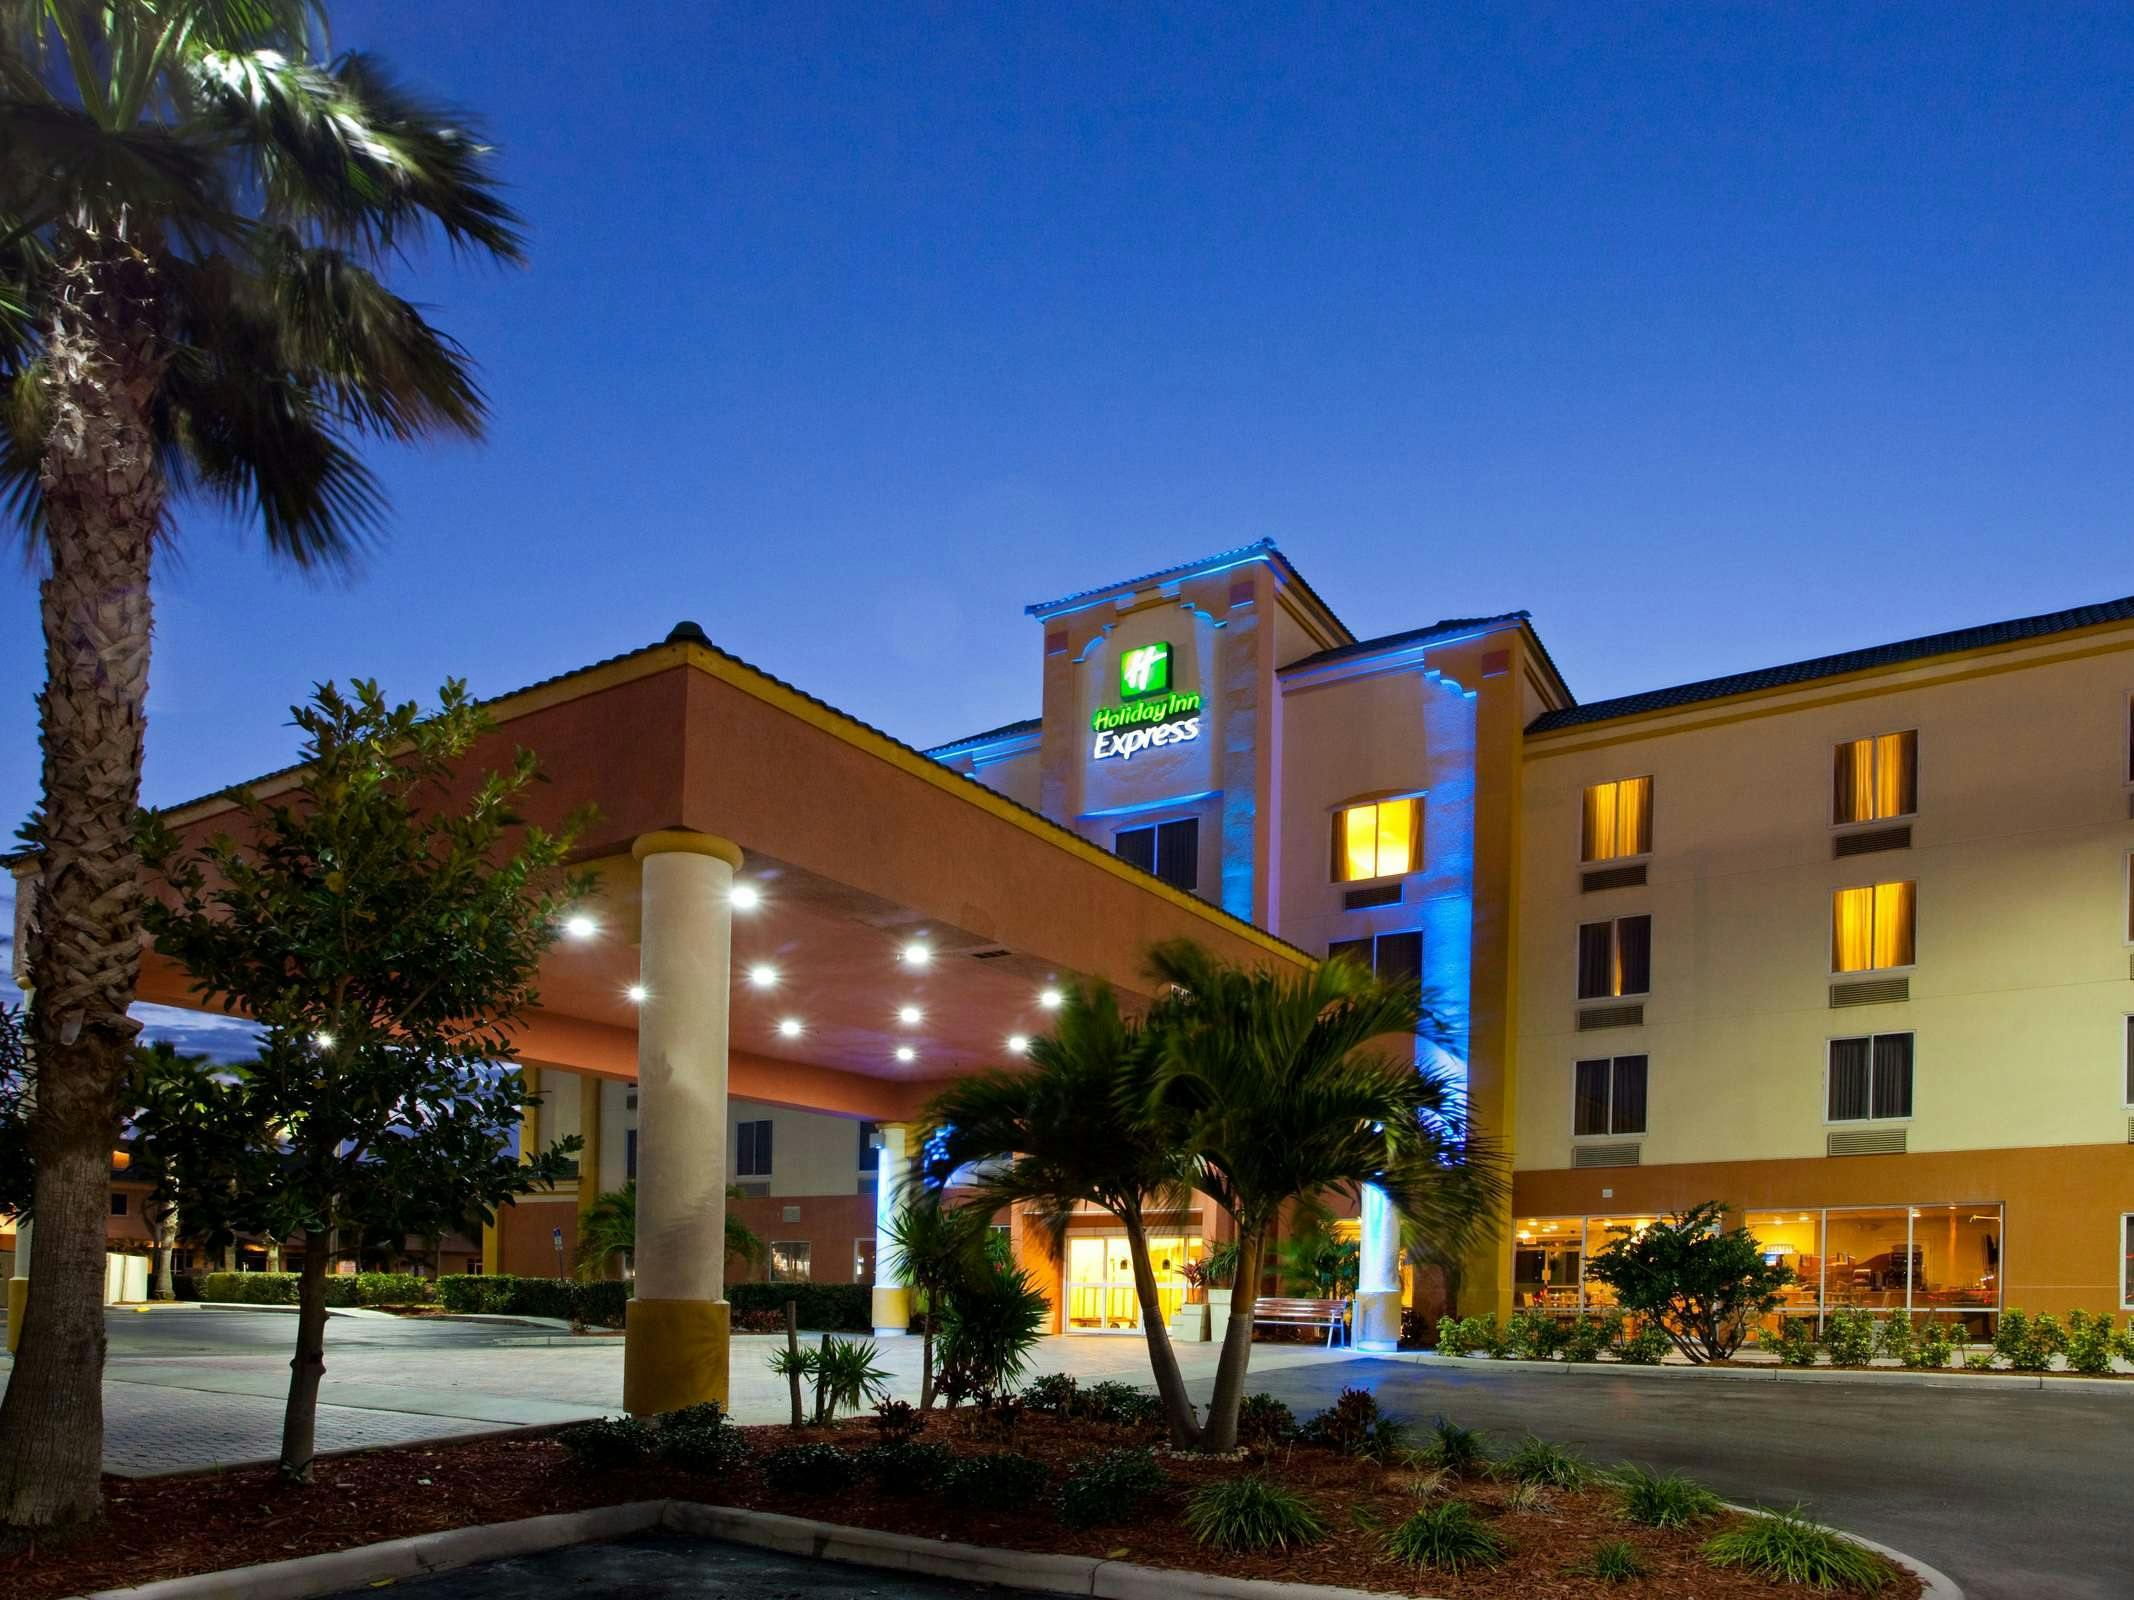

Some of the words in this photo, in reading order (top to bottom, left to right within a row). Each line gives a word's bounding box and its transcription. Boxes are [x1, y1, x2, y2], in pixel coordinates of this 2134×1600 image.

[1094, 703, 1167, 731] Holiday
[1168, 694, 1200, 714] Inn
[1094, 718, 1200, 760] Express
